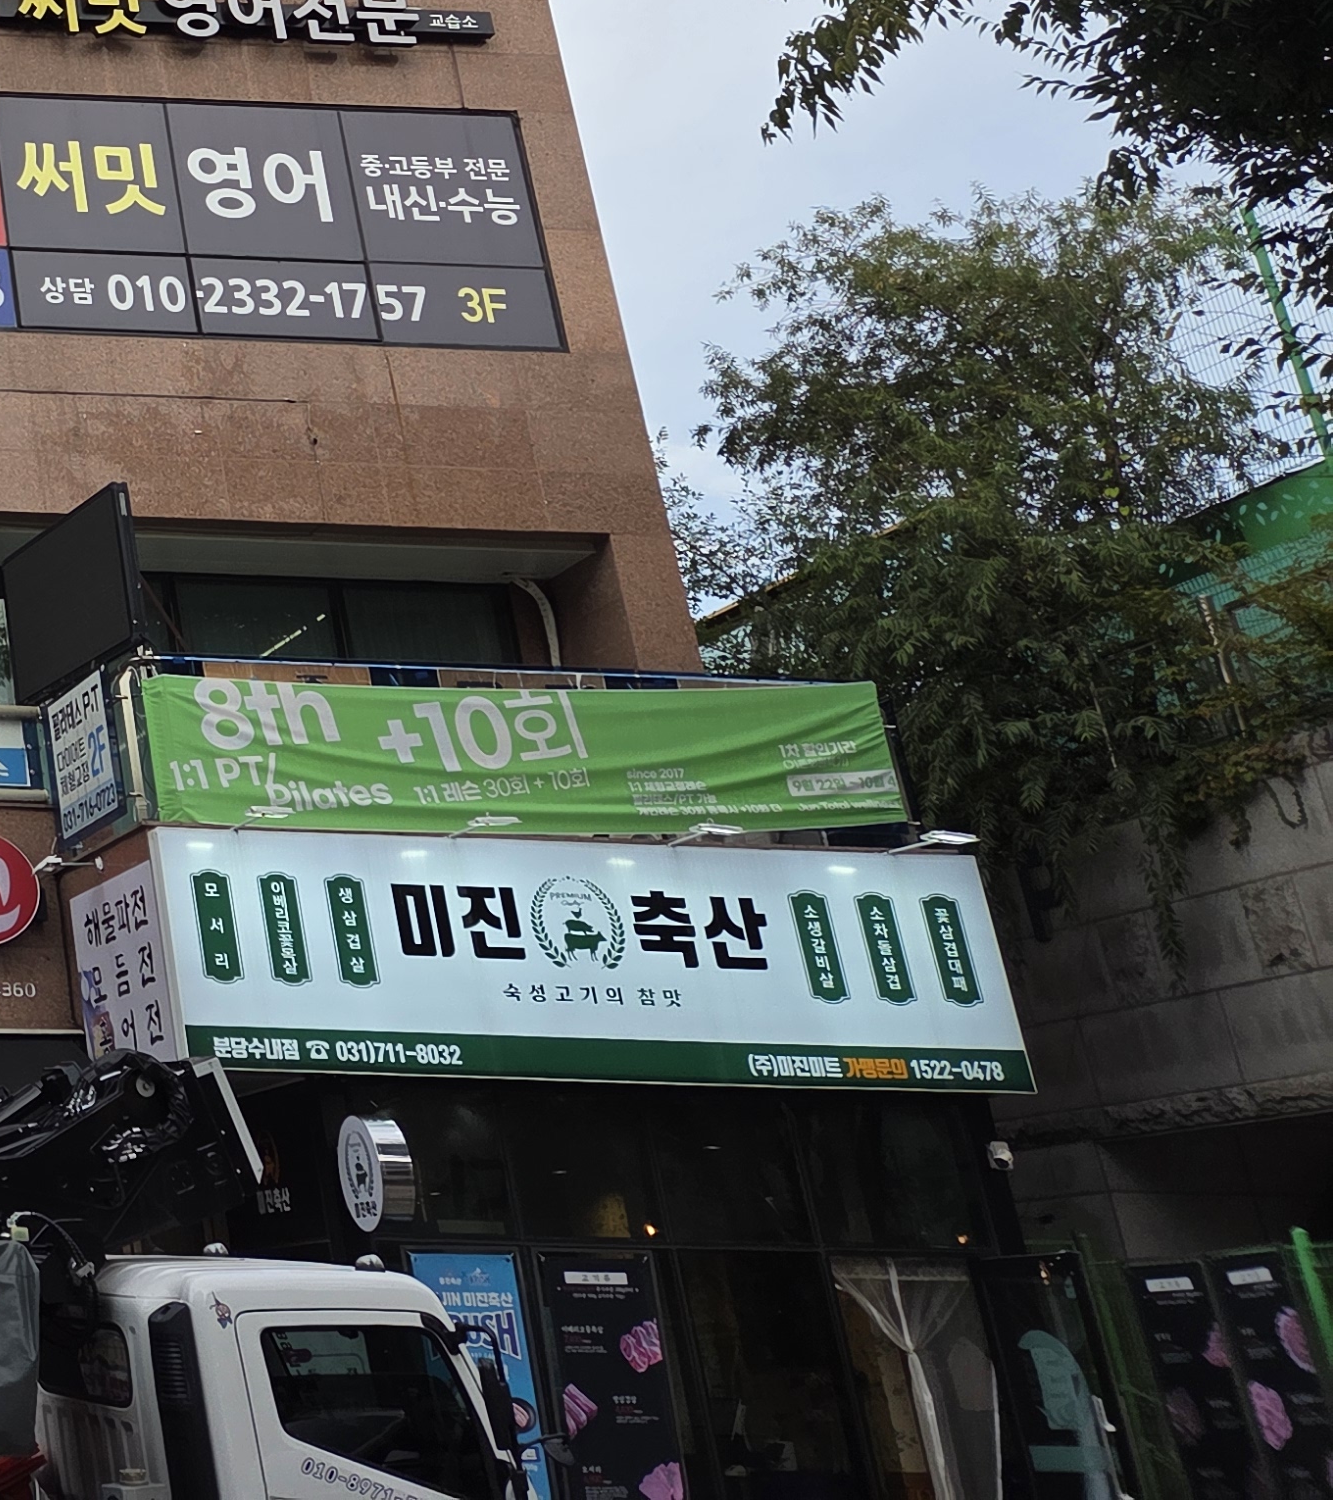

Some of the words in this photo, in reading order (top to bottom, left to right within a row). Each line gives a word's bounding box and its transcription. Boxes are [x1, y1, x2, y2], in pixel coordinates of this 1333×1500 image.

[429, 11, 479, 31] 교습소
[16, 140, 166, 216] 써밋
[186, 146, 334, 223] 영어
[463, 157, 511, 182] 전문
[40, 277, 94, 306] 상담
[107, 274, 427, 322] 010-2332-1757
[457, 286, 507, 324] 3F
[193, 678, 341, 750] 8th
[57, 737, 86, 773] 다이어트
[88, 724, 106, 779] 2F
[60, 760, 90, 797] 체형교정
[169, 758, 208, 791] 1:1
[442, 780, 483, 803] 레슨
[484, 774, 531, 799] 30회
[547, 767, 590, 793] 10회
[659, 768, 684, 779] 2017
[63, 783, 116, 832] 031-716-0723
[550, 891, 593, 903] PREMIUM
[84, 885, 149, 948] 해물파전
[338, 887, 365, 974] 생삼겹살
[390, 882, 526, 960] 미진
[630, 889, 768, 971] 축산
[804, 905, 834, 990] 소생갈비살
[503, 983, 624, 1007] 숙성고기의
[637, 987, 681, 1008] 참맛
[213, 1036, 300, 1060] 분당수내점
[336, 1040, 463, 1066] 031)711-8032
[748, 1054, 843, 1079] (주)미진미트
[843, 1056, 908, 1079] 가맹문의
[910, 1059, 1005, 1082] 1522-0478
